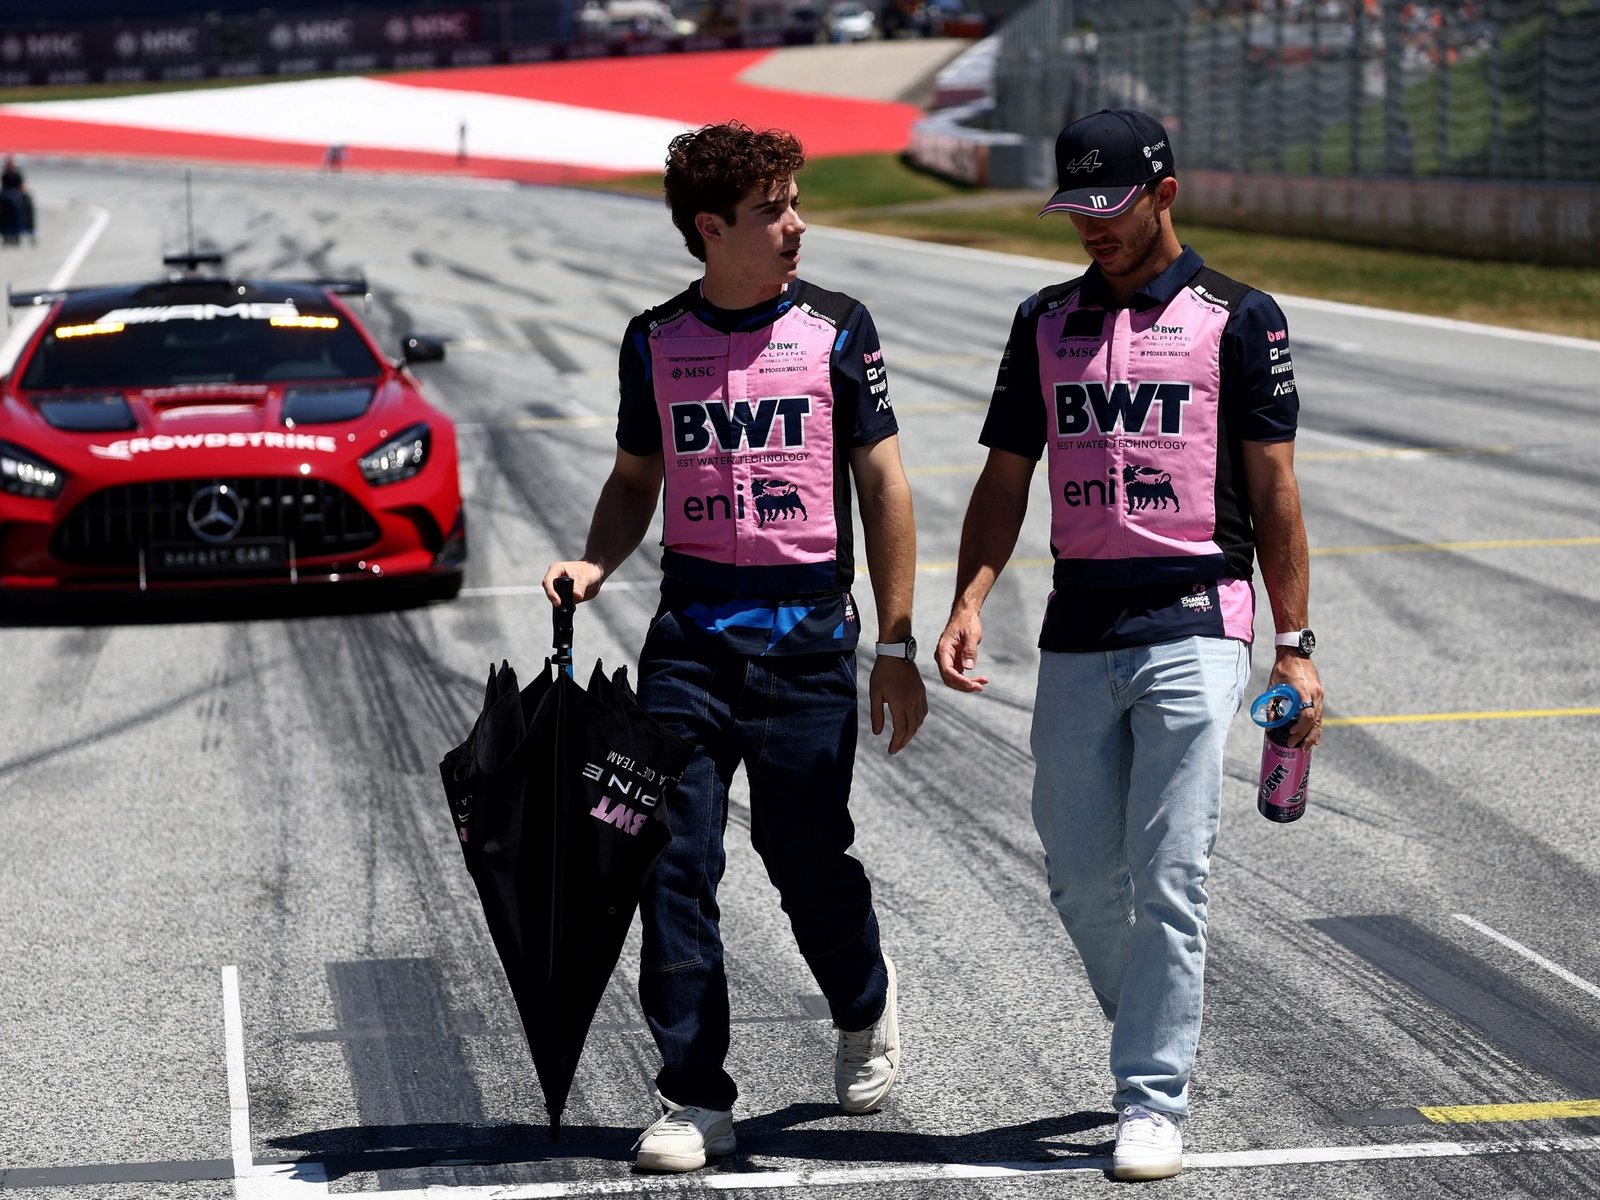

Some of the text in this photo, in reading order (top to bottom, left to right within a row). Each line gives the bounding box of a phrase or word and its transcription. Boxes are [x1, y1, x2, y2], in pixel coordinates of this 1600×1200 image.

[1203, 291, 1229, 307] Microsoft
[809, 309, 837, 326] Microsoft
[1161, 326, 1184, 334] BWT
[1275, 329, 1287, 341] BW
[760, 350, 807, 358] ALPINE
[1069, 347, 1100, 358] MSC
[684, 366, 716, 378] MSC
[1053, 380, 1194, 438] BWT
[669, 395, 812, 455] BWT
[1112, 440, 1187, 450] TECHNOLOGY
[677, 452, 810, 467] EST WATER TECHNOLOGY
[1063, 467, 1116, 507] eni
[683, 483, 745, 522] eni
[164, 546, 271, 566] SAFETY CAR
[1181, 595, 1210, 605] CHANGE
[606, 750, 636, 772] TEAM
[582, 762, 661, 807] PINE
[1265, 763, 1291, 792] BWT
[590, 795, 648, 836] BWT
